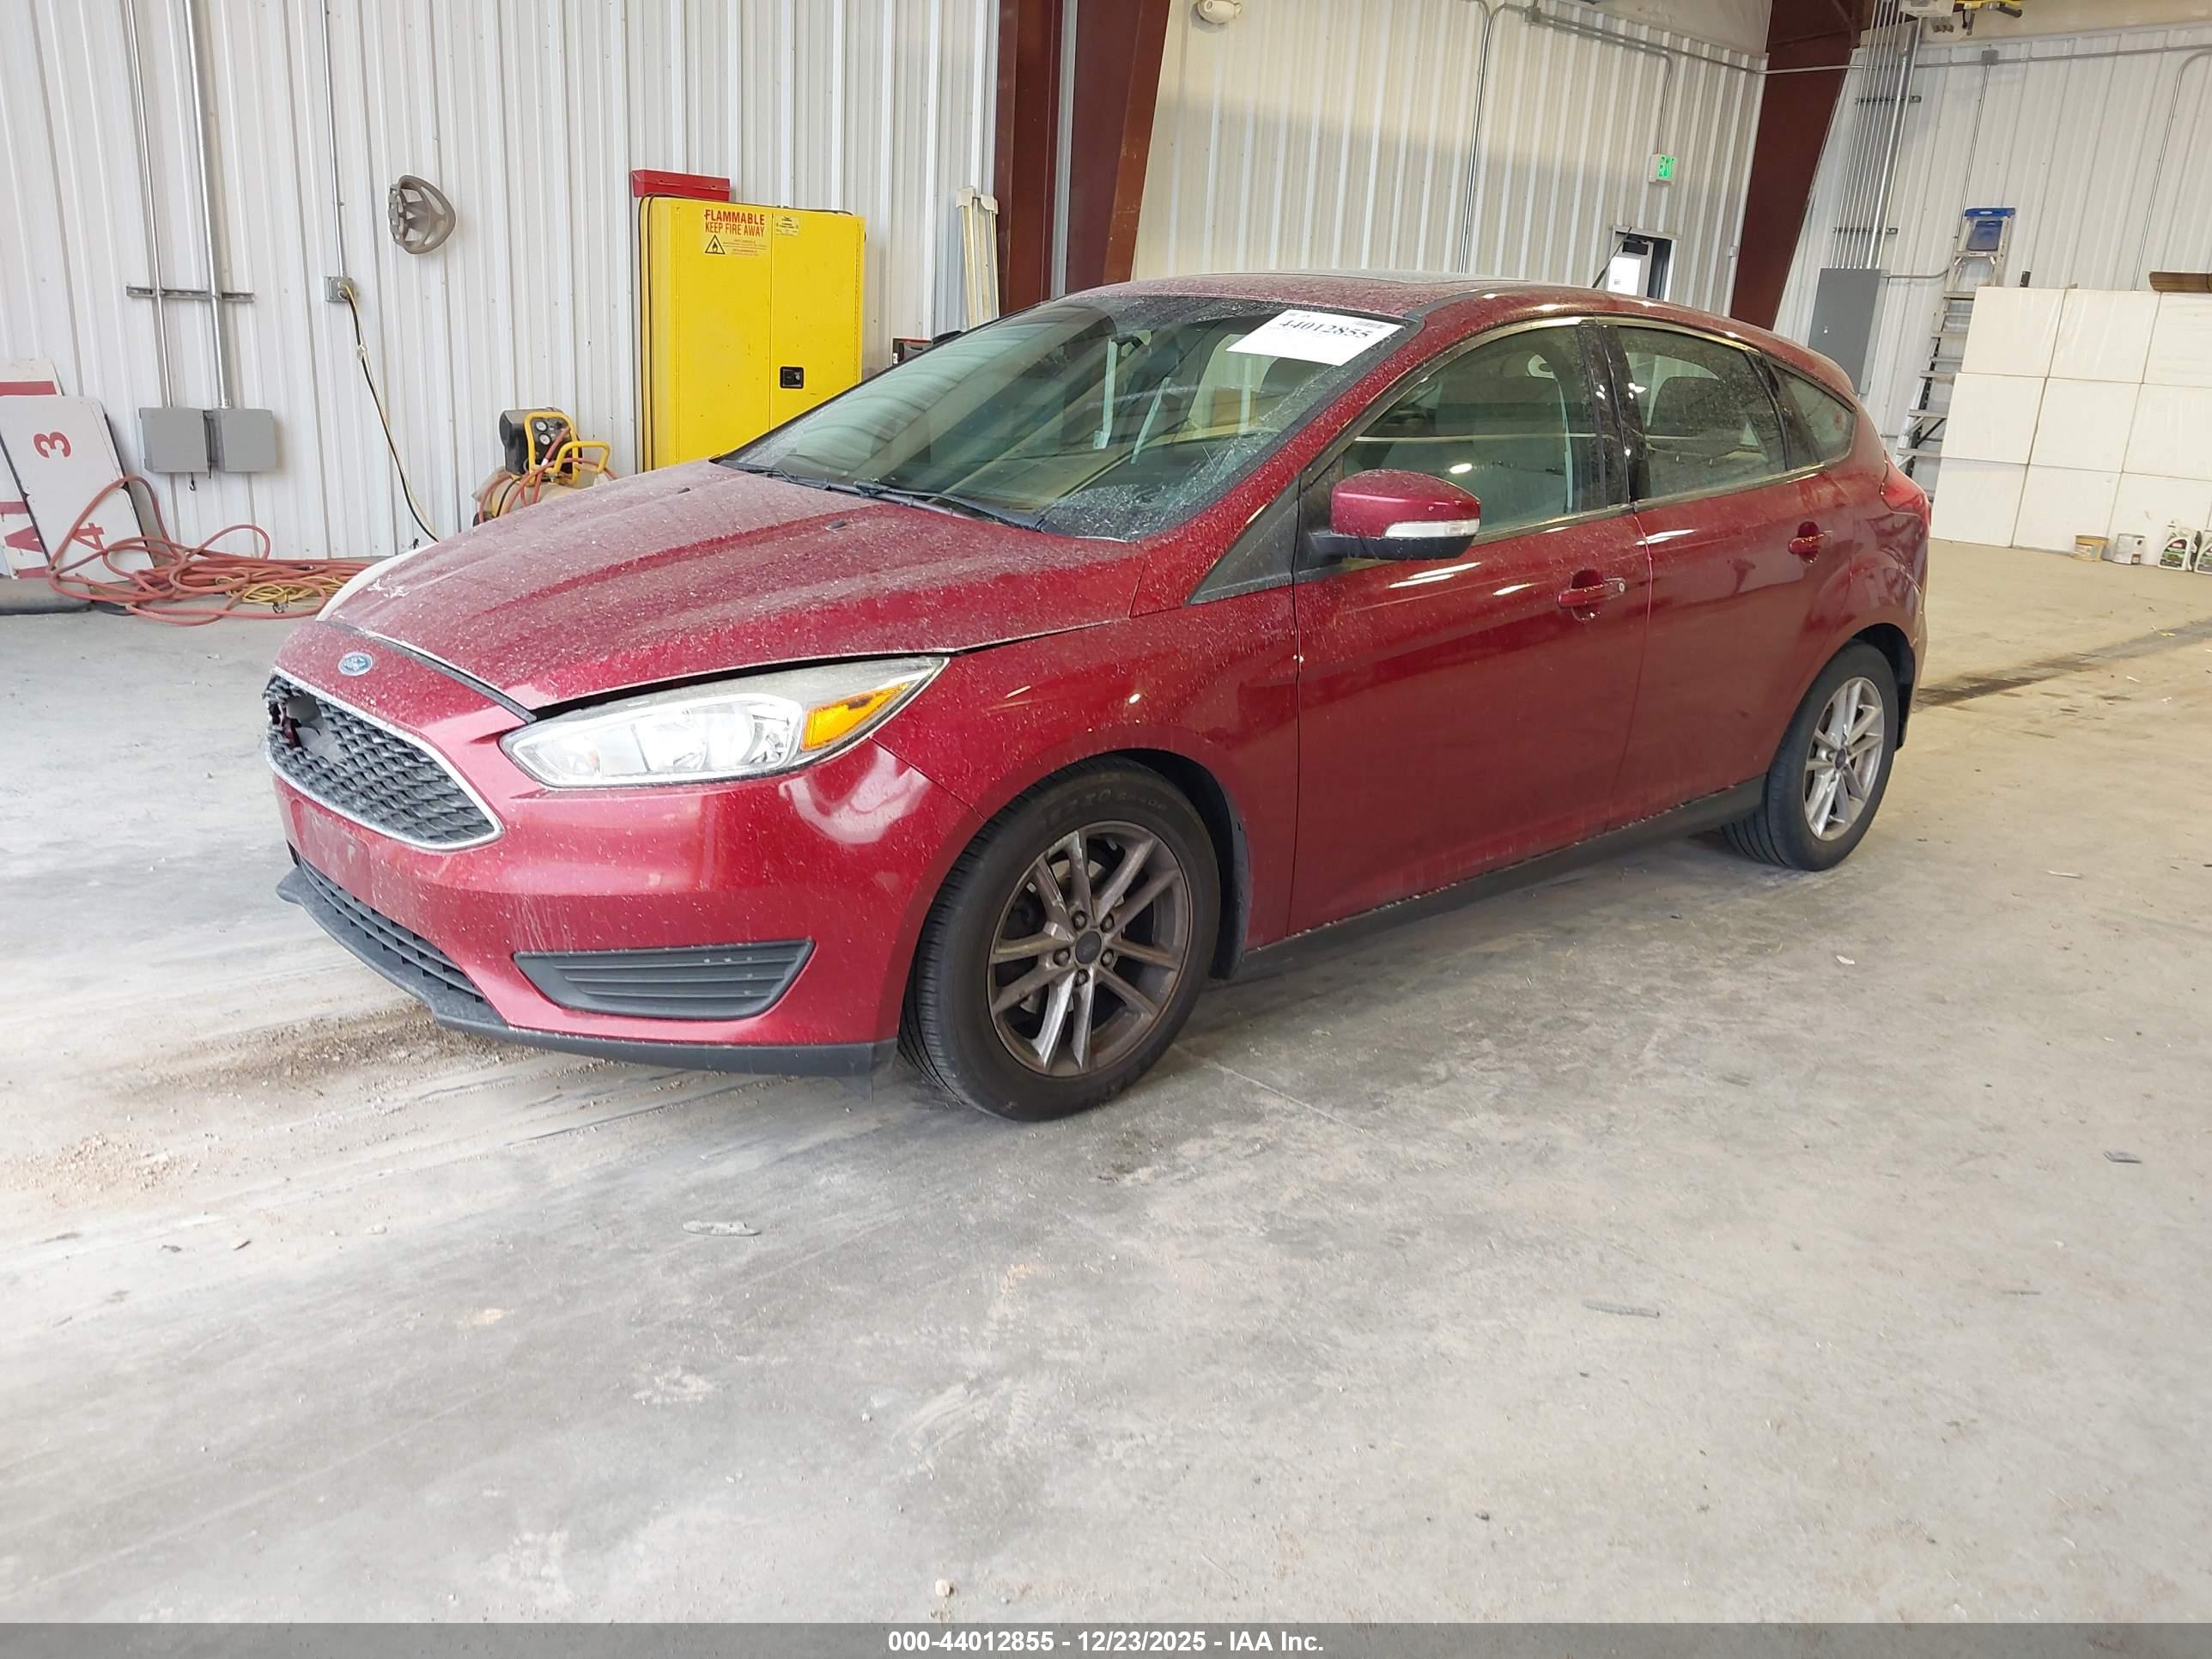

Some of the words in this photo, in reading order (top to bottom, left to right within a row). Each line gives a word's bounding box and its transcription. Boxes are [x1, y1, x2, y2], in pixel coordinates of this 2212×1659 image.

[704, 209, 765, 225] FLAMMABLE
[705, 221, 723, 234] KEEP
[725, 223, 742, 235] FIRE
[743, 225, 765, 238] AWAY
[1279, 319, 1374, 338] 44012855
[33, 432, 71, 459] 3
[71, 521, 106, 552] 4
